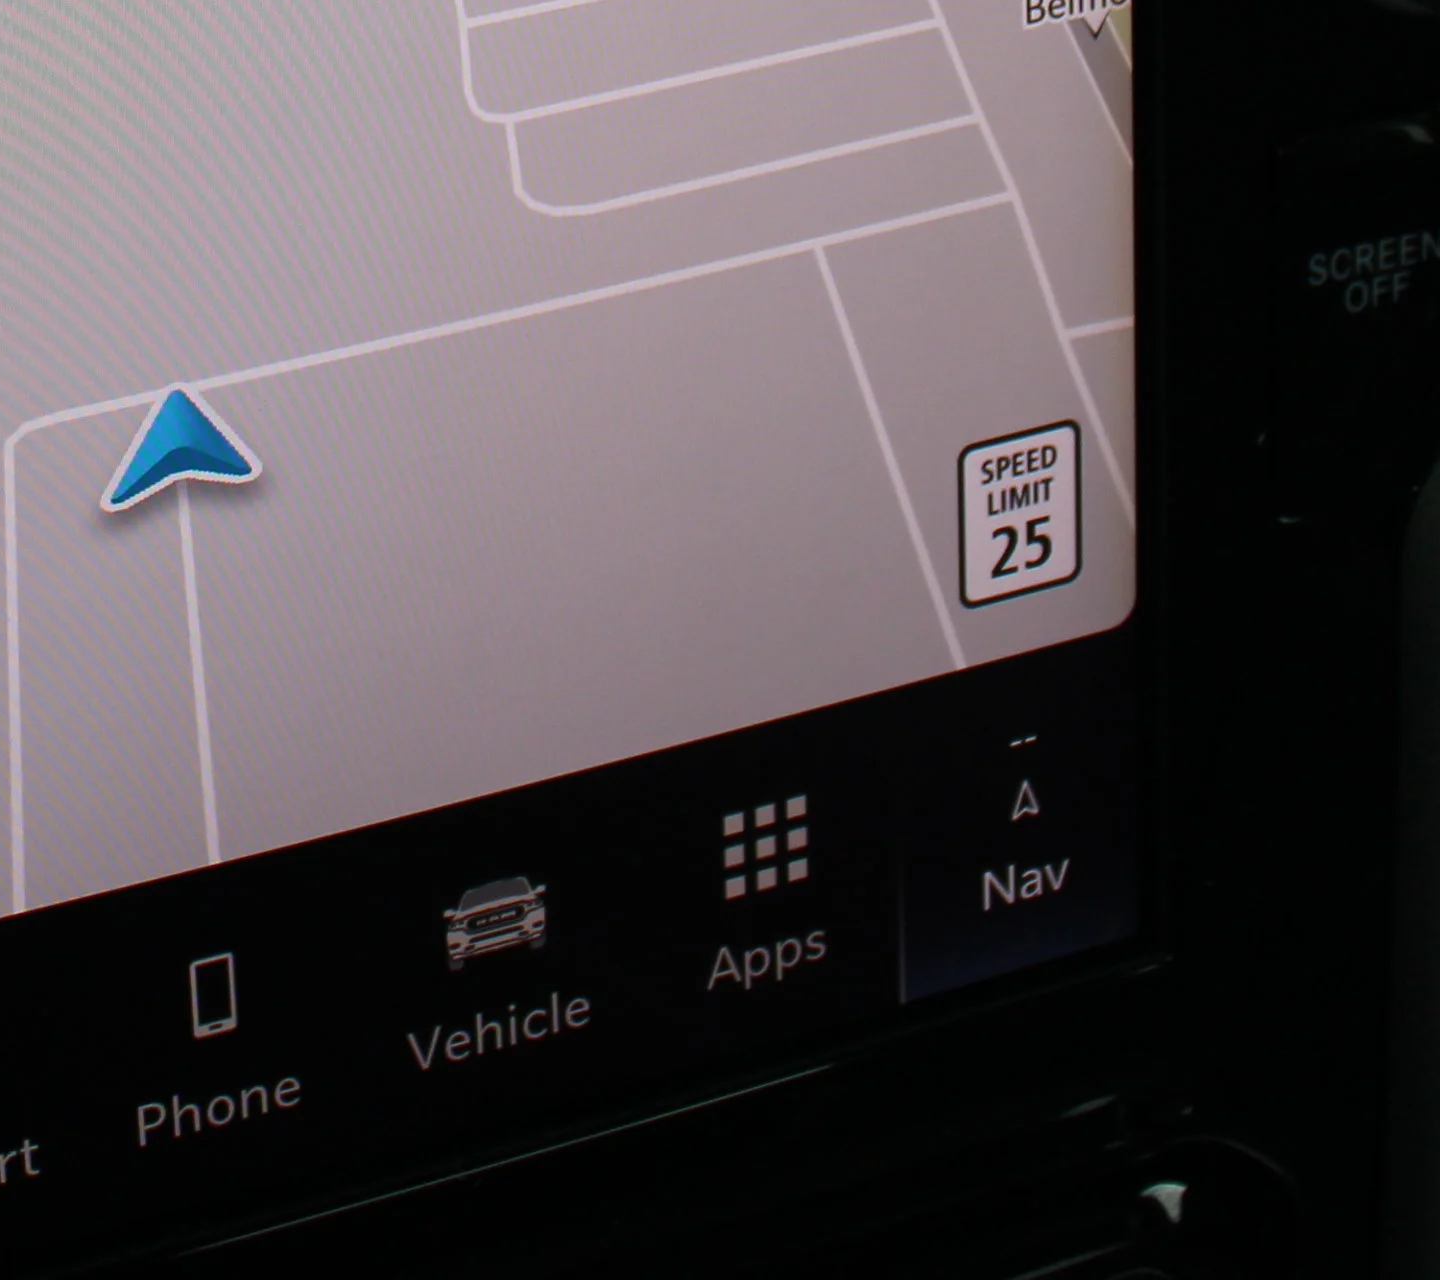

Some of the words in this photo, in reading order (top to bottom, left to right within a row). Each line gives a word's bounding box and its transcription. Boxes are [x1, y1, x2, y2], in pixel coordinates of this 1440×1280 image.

[1344, 270, 1412, 313] OFF
[980, 444, 1058, 486] SPEED
[987, 476, 1055, 516] LIMIT
[991, 514, 1053, 579] 25
[981, 857, 1071, 913] Nav
[706, 924, 829, 992] Apps
[406, 990, 593, 1072] Vehicle
[136, 1073, 303, 1148] Phone
